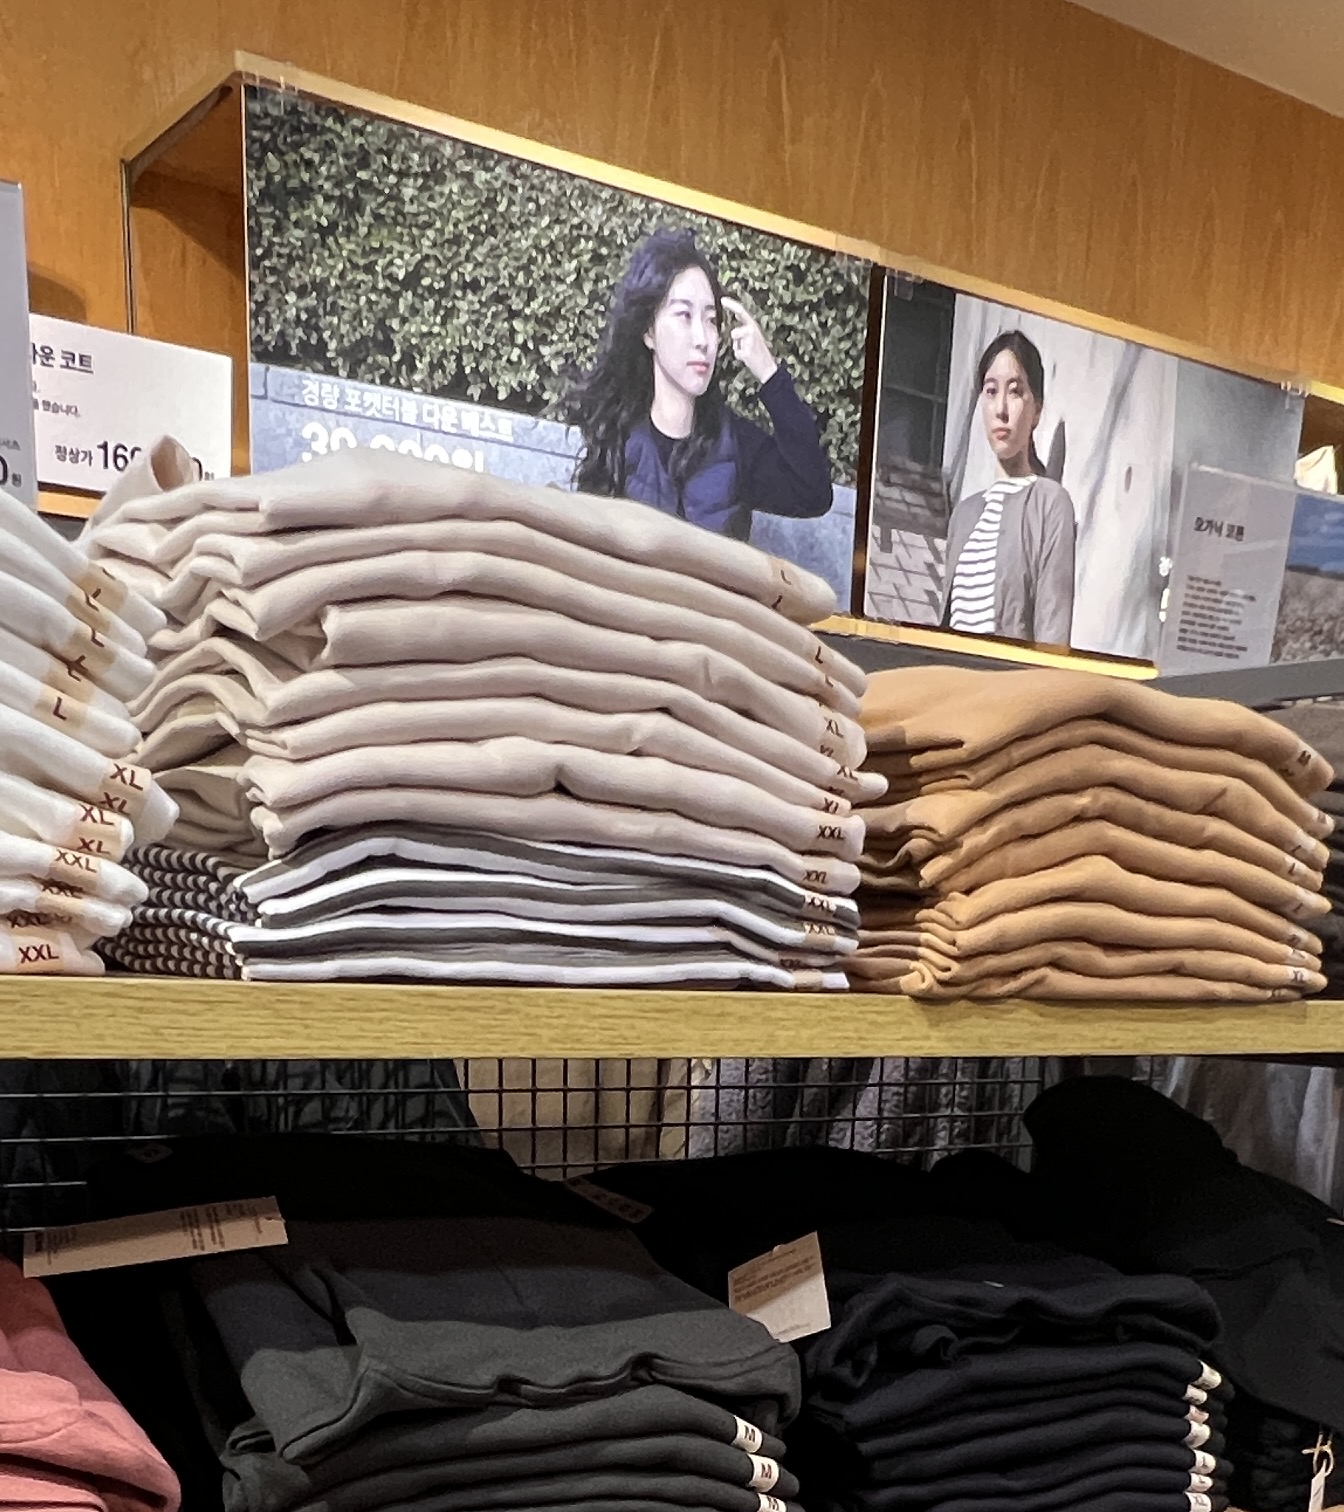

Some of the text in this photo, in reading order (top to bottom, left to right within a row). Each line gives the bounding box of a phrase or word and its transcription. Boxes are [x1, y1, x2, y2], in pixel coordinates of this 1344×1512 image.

[60, 349, 94, 375] 코트
[423, 402, 459, 432] 다운
[55, 445, 93, 467] 정상가
[54, 697, 67, 721] L
[109, 763, 144, 791] XL
[79, 804, 115, 826] XL
[817, 825, 845, 840] XXL
[78, 837, 111, 855] XL
[55, 849, 98, 873] XXL
[19, 944, 59, 963] XXL
[744, 1425, 756, 1443] M
[760, 1462, 772, 1479] M
